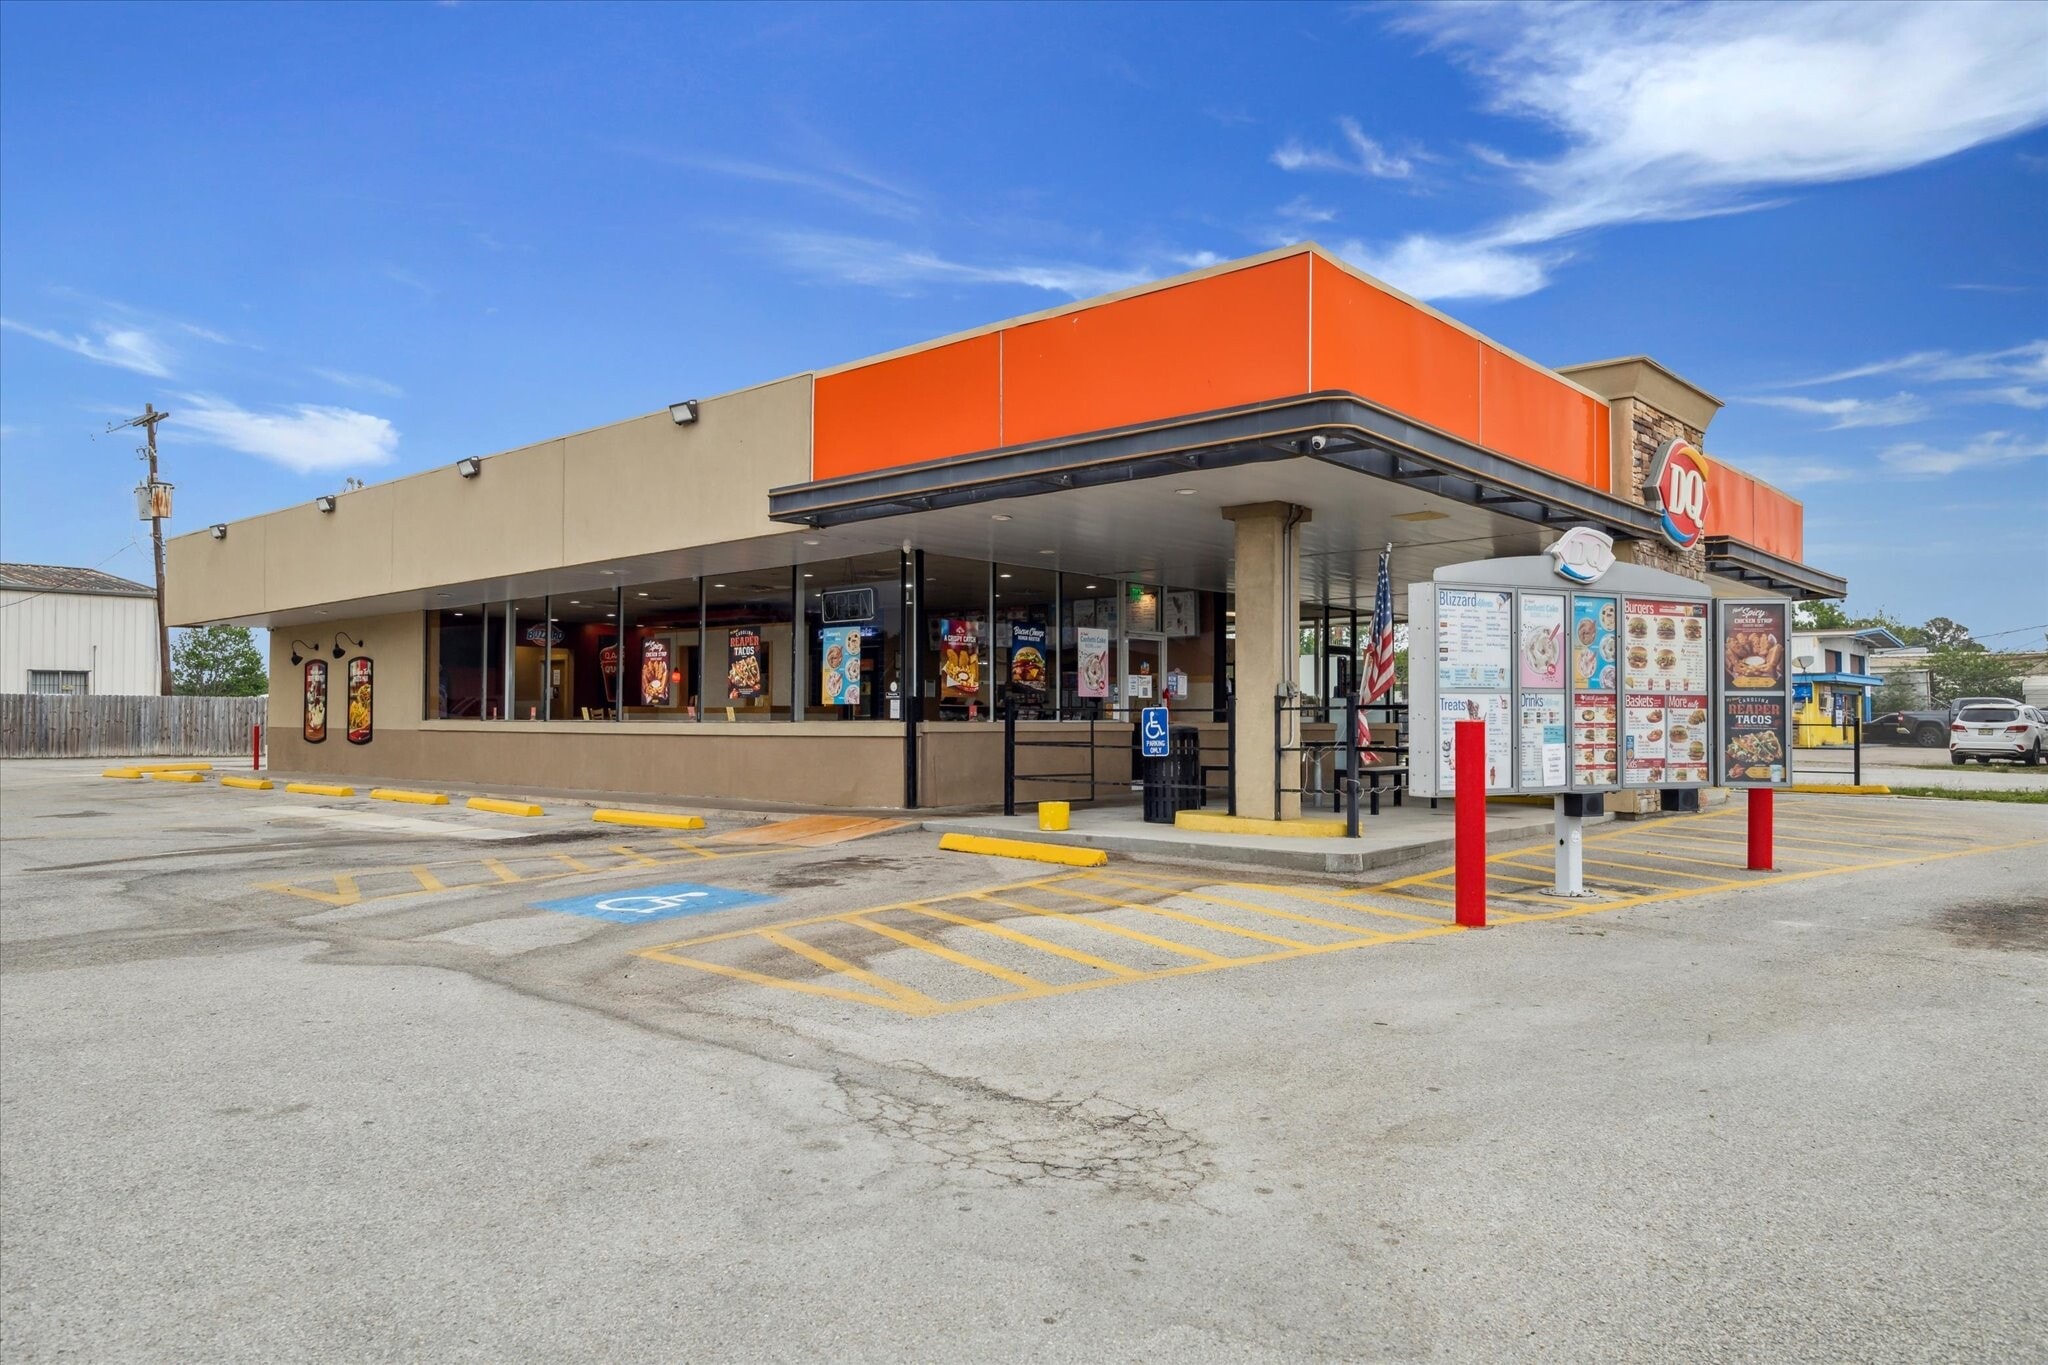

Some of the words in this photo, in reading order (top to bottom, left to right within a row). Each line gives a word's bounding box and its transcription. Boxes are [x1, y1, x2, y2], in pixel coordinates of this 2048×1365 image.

[1668, 462, 1704, 529] DQ
[1439, 591, 1477, 607] Blizzard
[825, 591, 872, 620] OPEN
[1625, 600, 1654, 614] Burgers
[1742, 607, 1765, 618] Spicy
[528, 629, 564, 640] BLIZZRD
[730, 635, 759, 647] REAPER
[734, 646, 754, 656] TACOS
[1440, 697, 1466, 711] Treats
[1521, 693, 1543, 707] Drinks
[1625, 694, 1654, 707] Baskets
[1668, 695, 1687, 707] More
[1728, 703, 1780, 714] REAPER
[1735, 714, 1772, 724] TACOS
